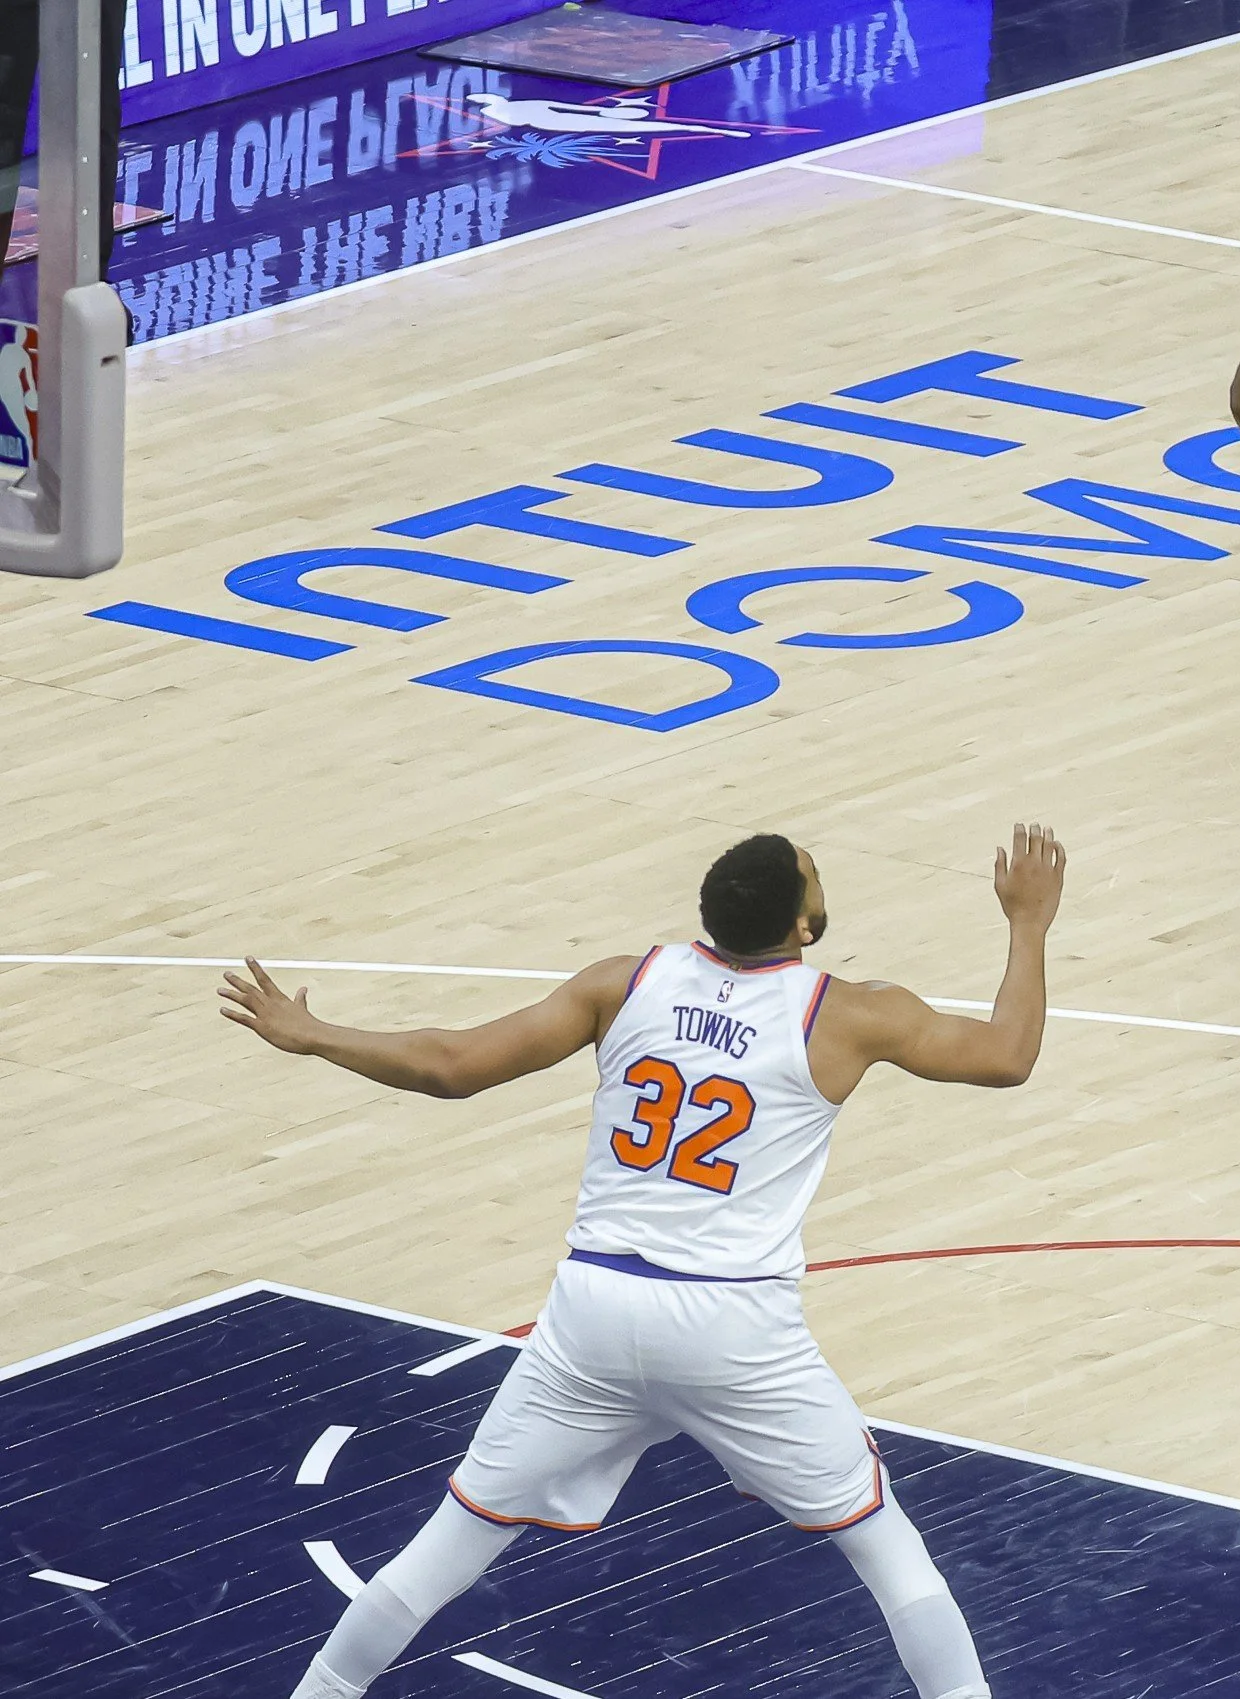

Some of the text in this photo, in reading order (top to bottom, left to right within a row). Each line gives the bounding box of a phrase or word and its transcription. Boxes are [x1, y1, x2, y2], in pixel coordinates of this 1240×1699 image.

[162, 0, 220, 77] IN
[83, 350, 1146, 661] INTUIT
[673, 1005, 757, 1060] TOWNS
[609, 1054, 757, 1196] 32
